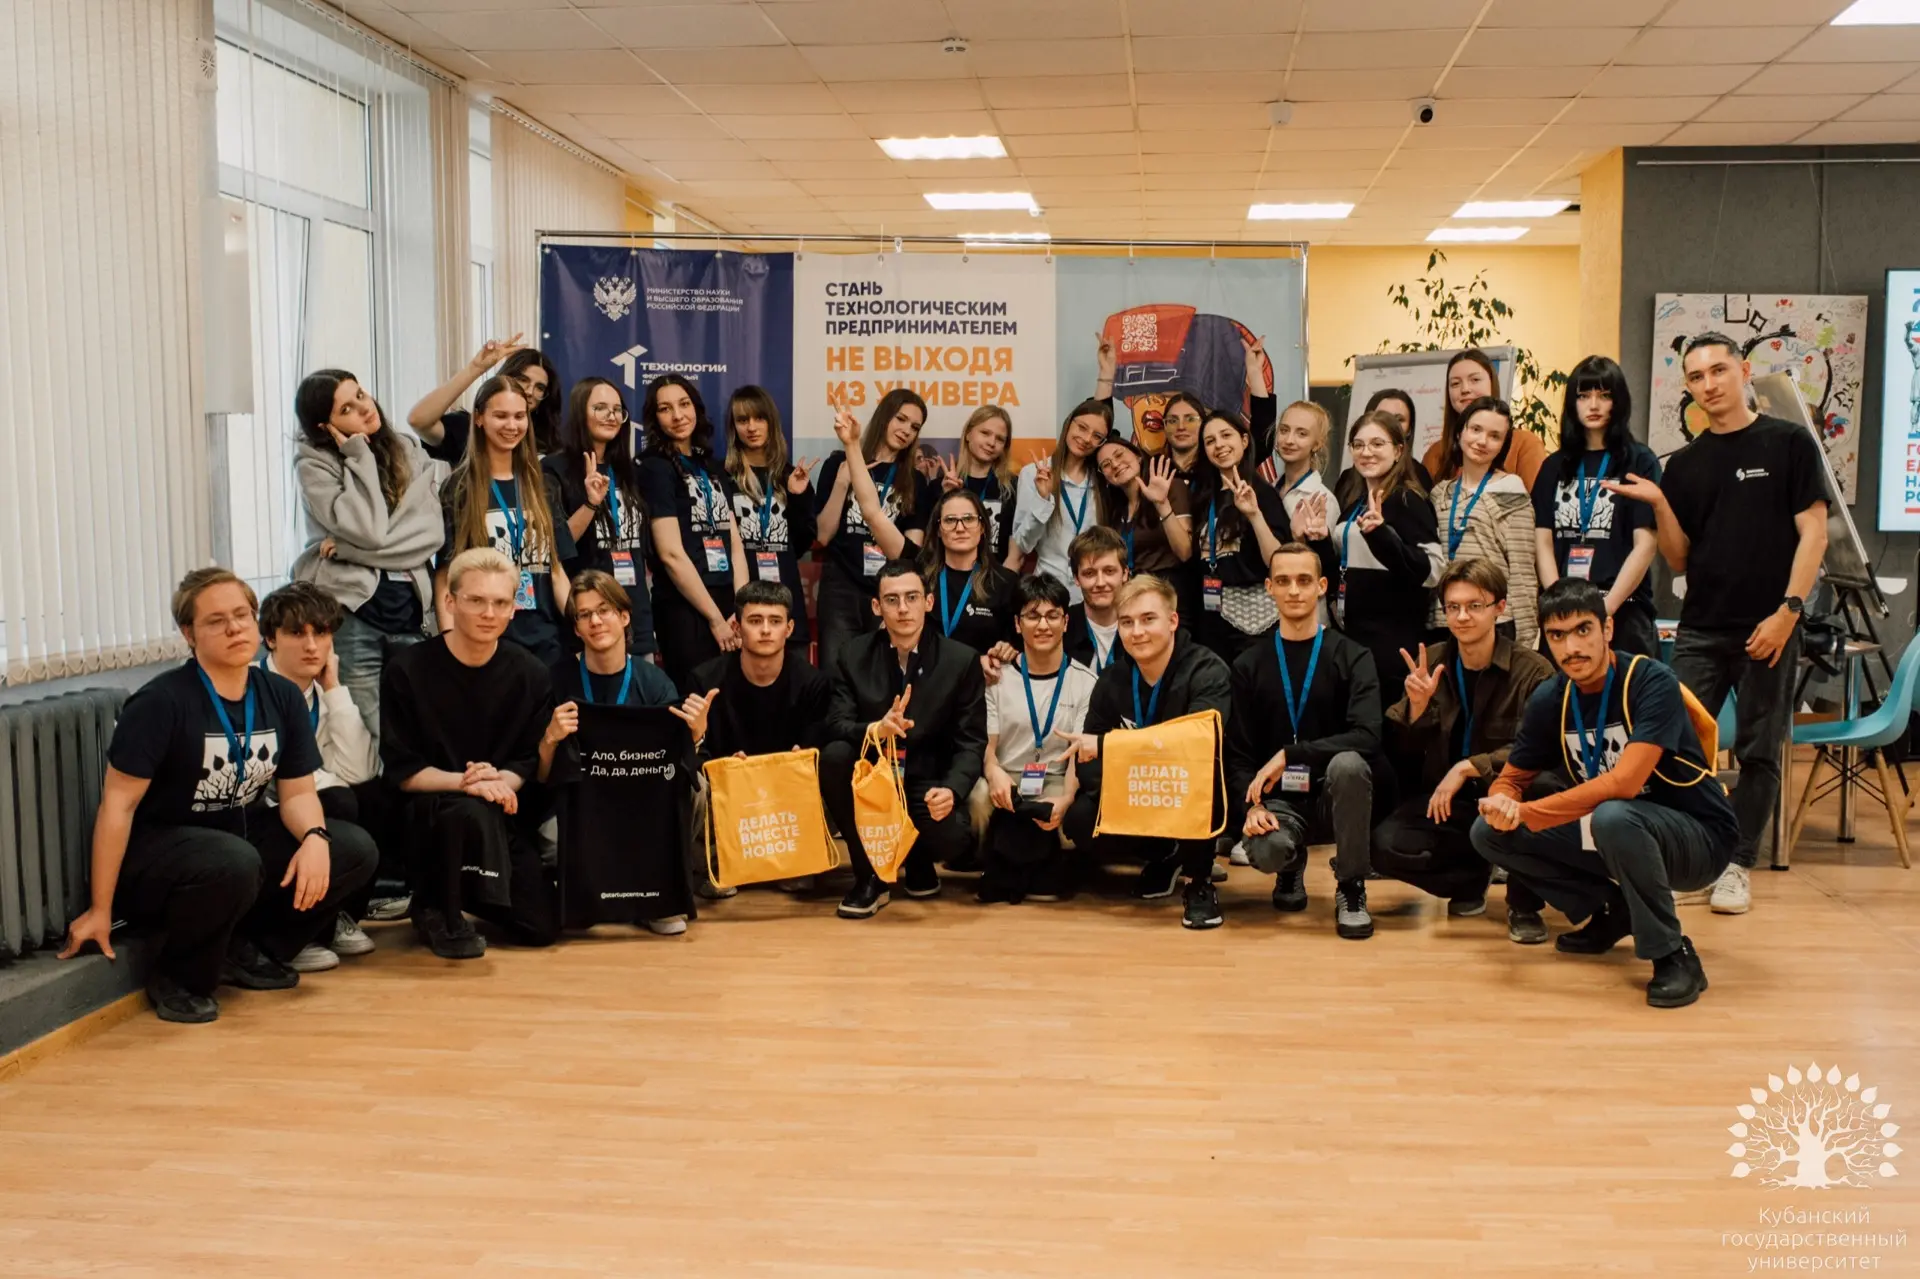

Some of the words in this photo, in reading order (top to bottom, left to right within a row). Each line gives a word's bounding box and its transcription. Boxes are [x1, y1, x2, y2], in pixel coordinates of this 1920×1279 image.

[646, 287, 705, 296] МИНИСТЕРСТВО
[825, 281, 883, 297] СТАНЬ
[646, 303, 696, 311] РОССИЙСКОЙ
[696, 304, 740, 312] ФЕДЕРАЦИИ
[691, 297, 744, 305] ОБРАЗОВАНИЯ
[825, 300, 1007, 316] ТЕХНОЛОГИЧЕСКИМ
[825, 320, 1018, 336] ПРЕДПРИНИМАТЕЛЕМ
[640, 362, 728, 373] ТЕХНОЛОГИИ
[826, 346, 865, 372] НЕ
[873, 346, 1014, 376] ВЫХОДЯ
[826, 381, 866, 407] ИЗ
[591, 750, 617, 762] Ало,
[619, 749, 666, 760] бизнес?
[590, 765, 609, 777] Да,
[611, 767, 629, 777] да,
[1127, 766, 1190, 780] ДЕЛАТЬ
[1128, 780, 1189, 794] ВМЕСТЕ
[1128, 795, 1183, 808] НОВОЕ
[738, 811, 798, 833] ДЕЛАТЬ
[740, 824, 800, 845] ВМЕСТЕ
[743, 839, 798, 860] НОВОЕ
